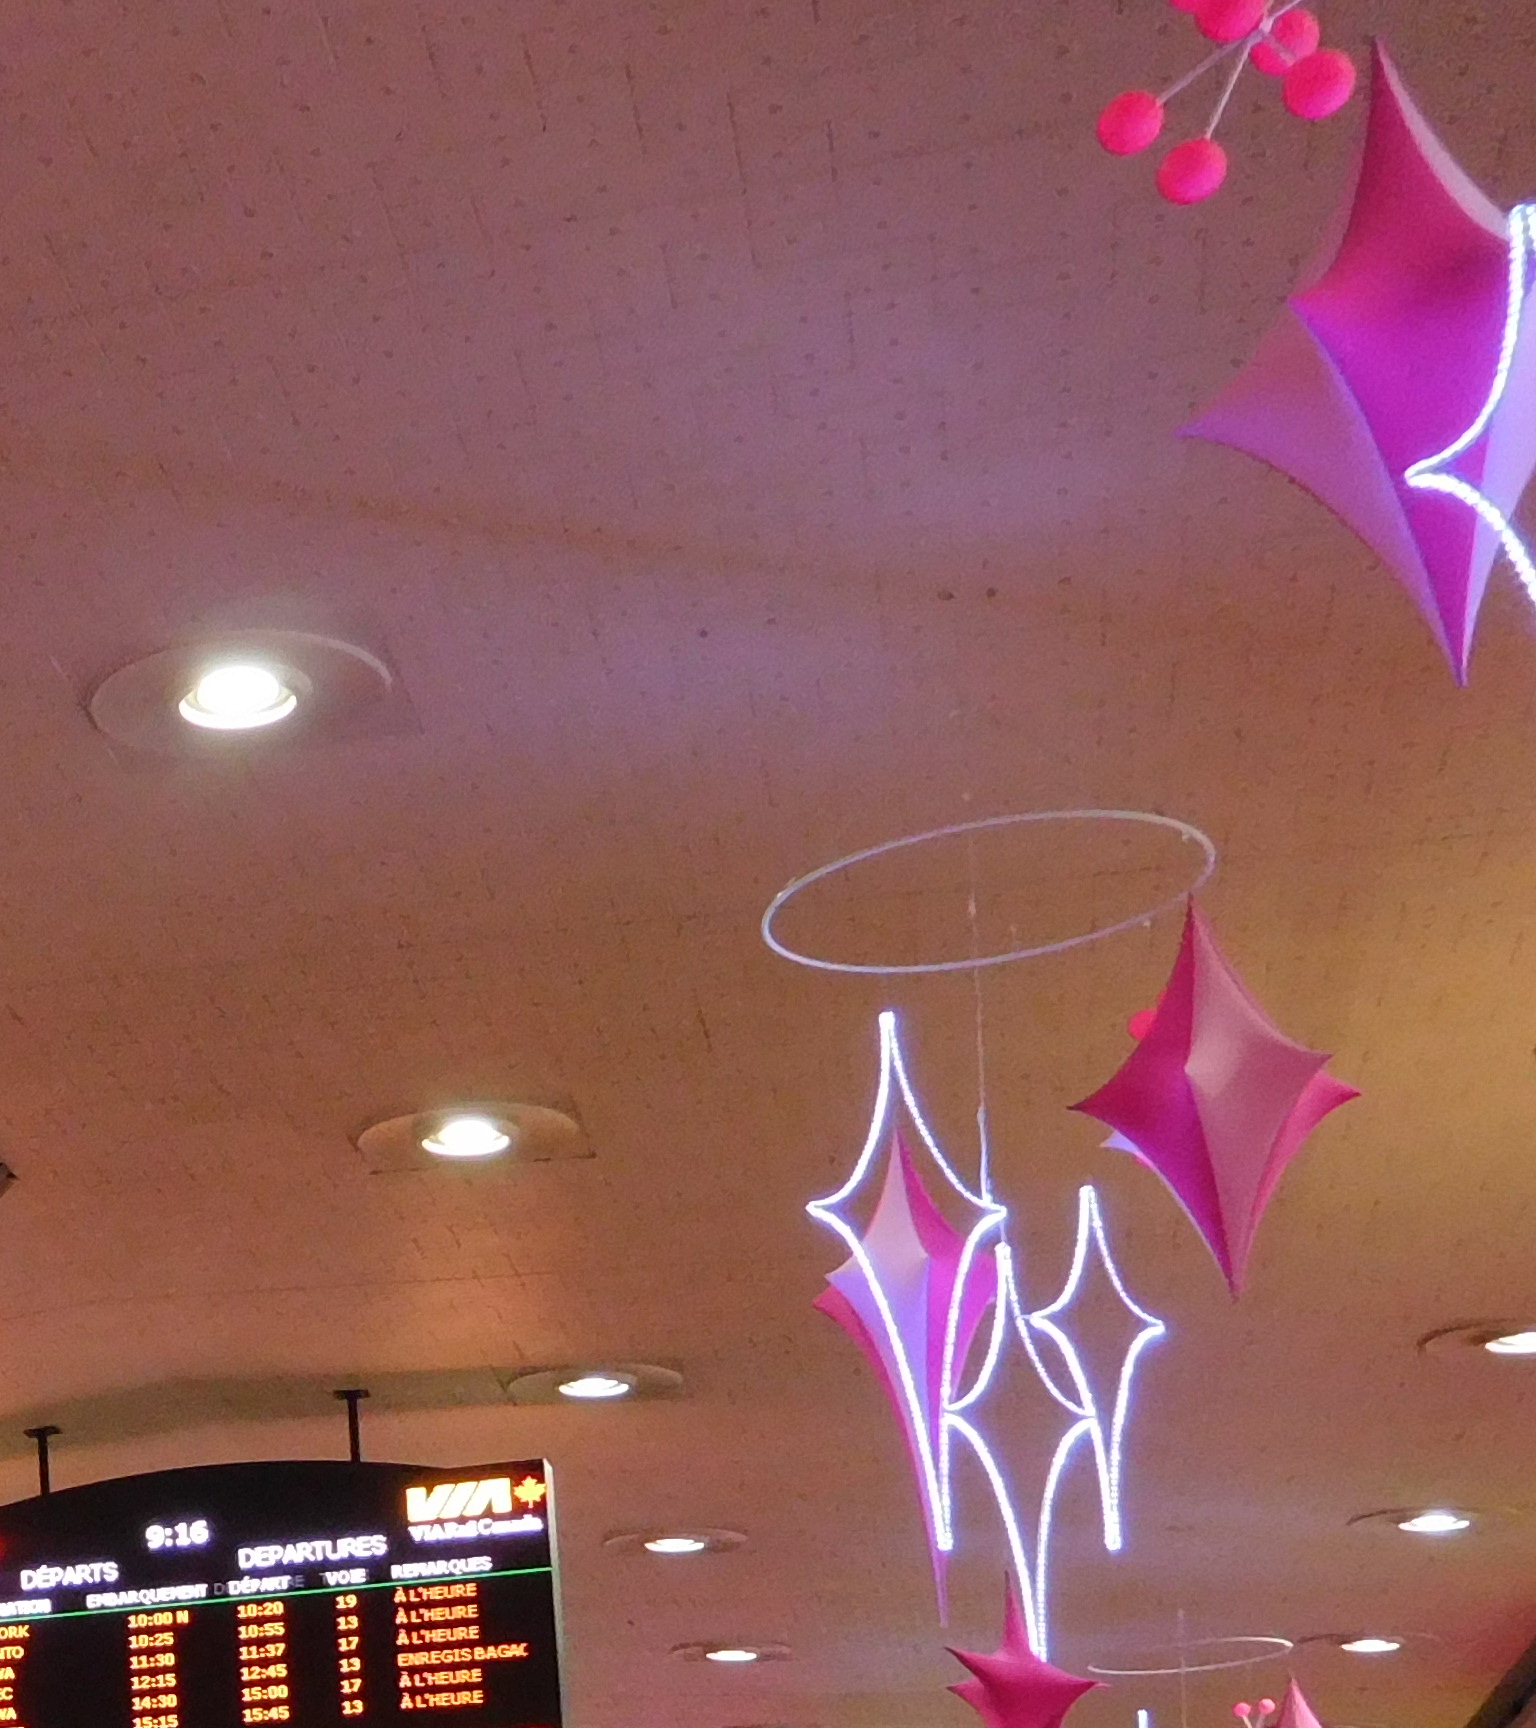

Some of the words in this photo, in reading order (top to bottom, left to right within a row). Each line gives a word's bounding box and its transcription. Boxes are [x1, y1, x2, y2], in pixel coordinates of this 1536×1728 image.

[406, 1477, 513, 1523] VIA
[145, 1520, 210, 1550] 9:16
[238, 1534, 388, 1570] DEPARTURES
[20, 1562, 120, 1590] DÉPARTS
[391, 1556, 494, 1580] REMARQUES
[127, 1612, 174, 1629] 10:00
[176, 1610, 190, 1625] N
[237, 1601, 284, 1620] 10:20
[335, 1594, 358, 1610] 19
[394, 1586, 408, 1604] À
[128, 1632, 174, 1649] 10:25
[238, 1622, 286, 1640] 10:55
[337, 1616, 359, 1631] 13
[395, 1607, 409, 1625] À
[129, 1653, 175, 1669] 11:30
[239, 1643, 286, 1660] 11:37
[338, 1637, 360, 1652] 17
[396, 1628, 410, 1647] À
[130, 1673, 177, 1690] 12:15
[240, 1664, 288, 1681] 12:45
[339, 1658, 361, 1673] 13
[397, 1648, 472, 1668] ENREGIS
[131, 1694, 178, 1711] 14:30
[241, 1685, 289, 1702] 15:00
[340, 1679, 362, 1694] 17
[399, 1671, 413, 1689] À
[243, 1706, 290, 1724] 15:45
[341, 1700, 364, 1716] 13
[400, 1693, 414, 1710] À
